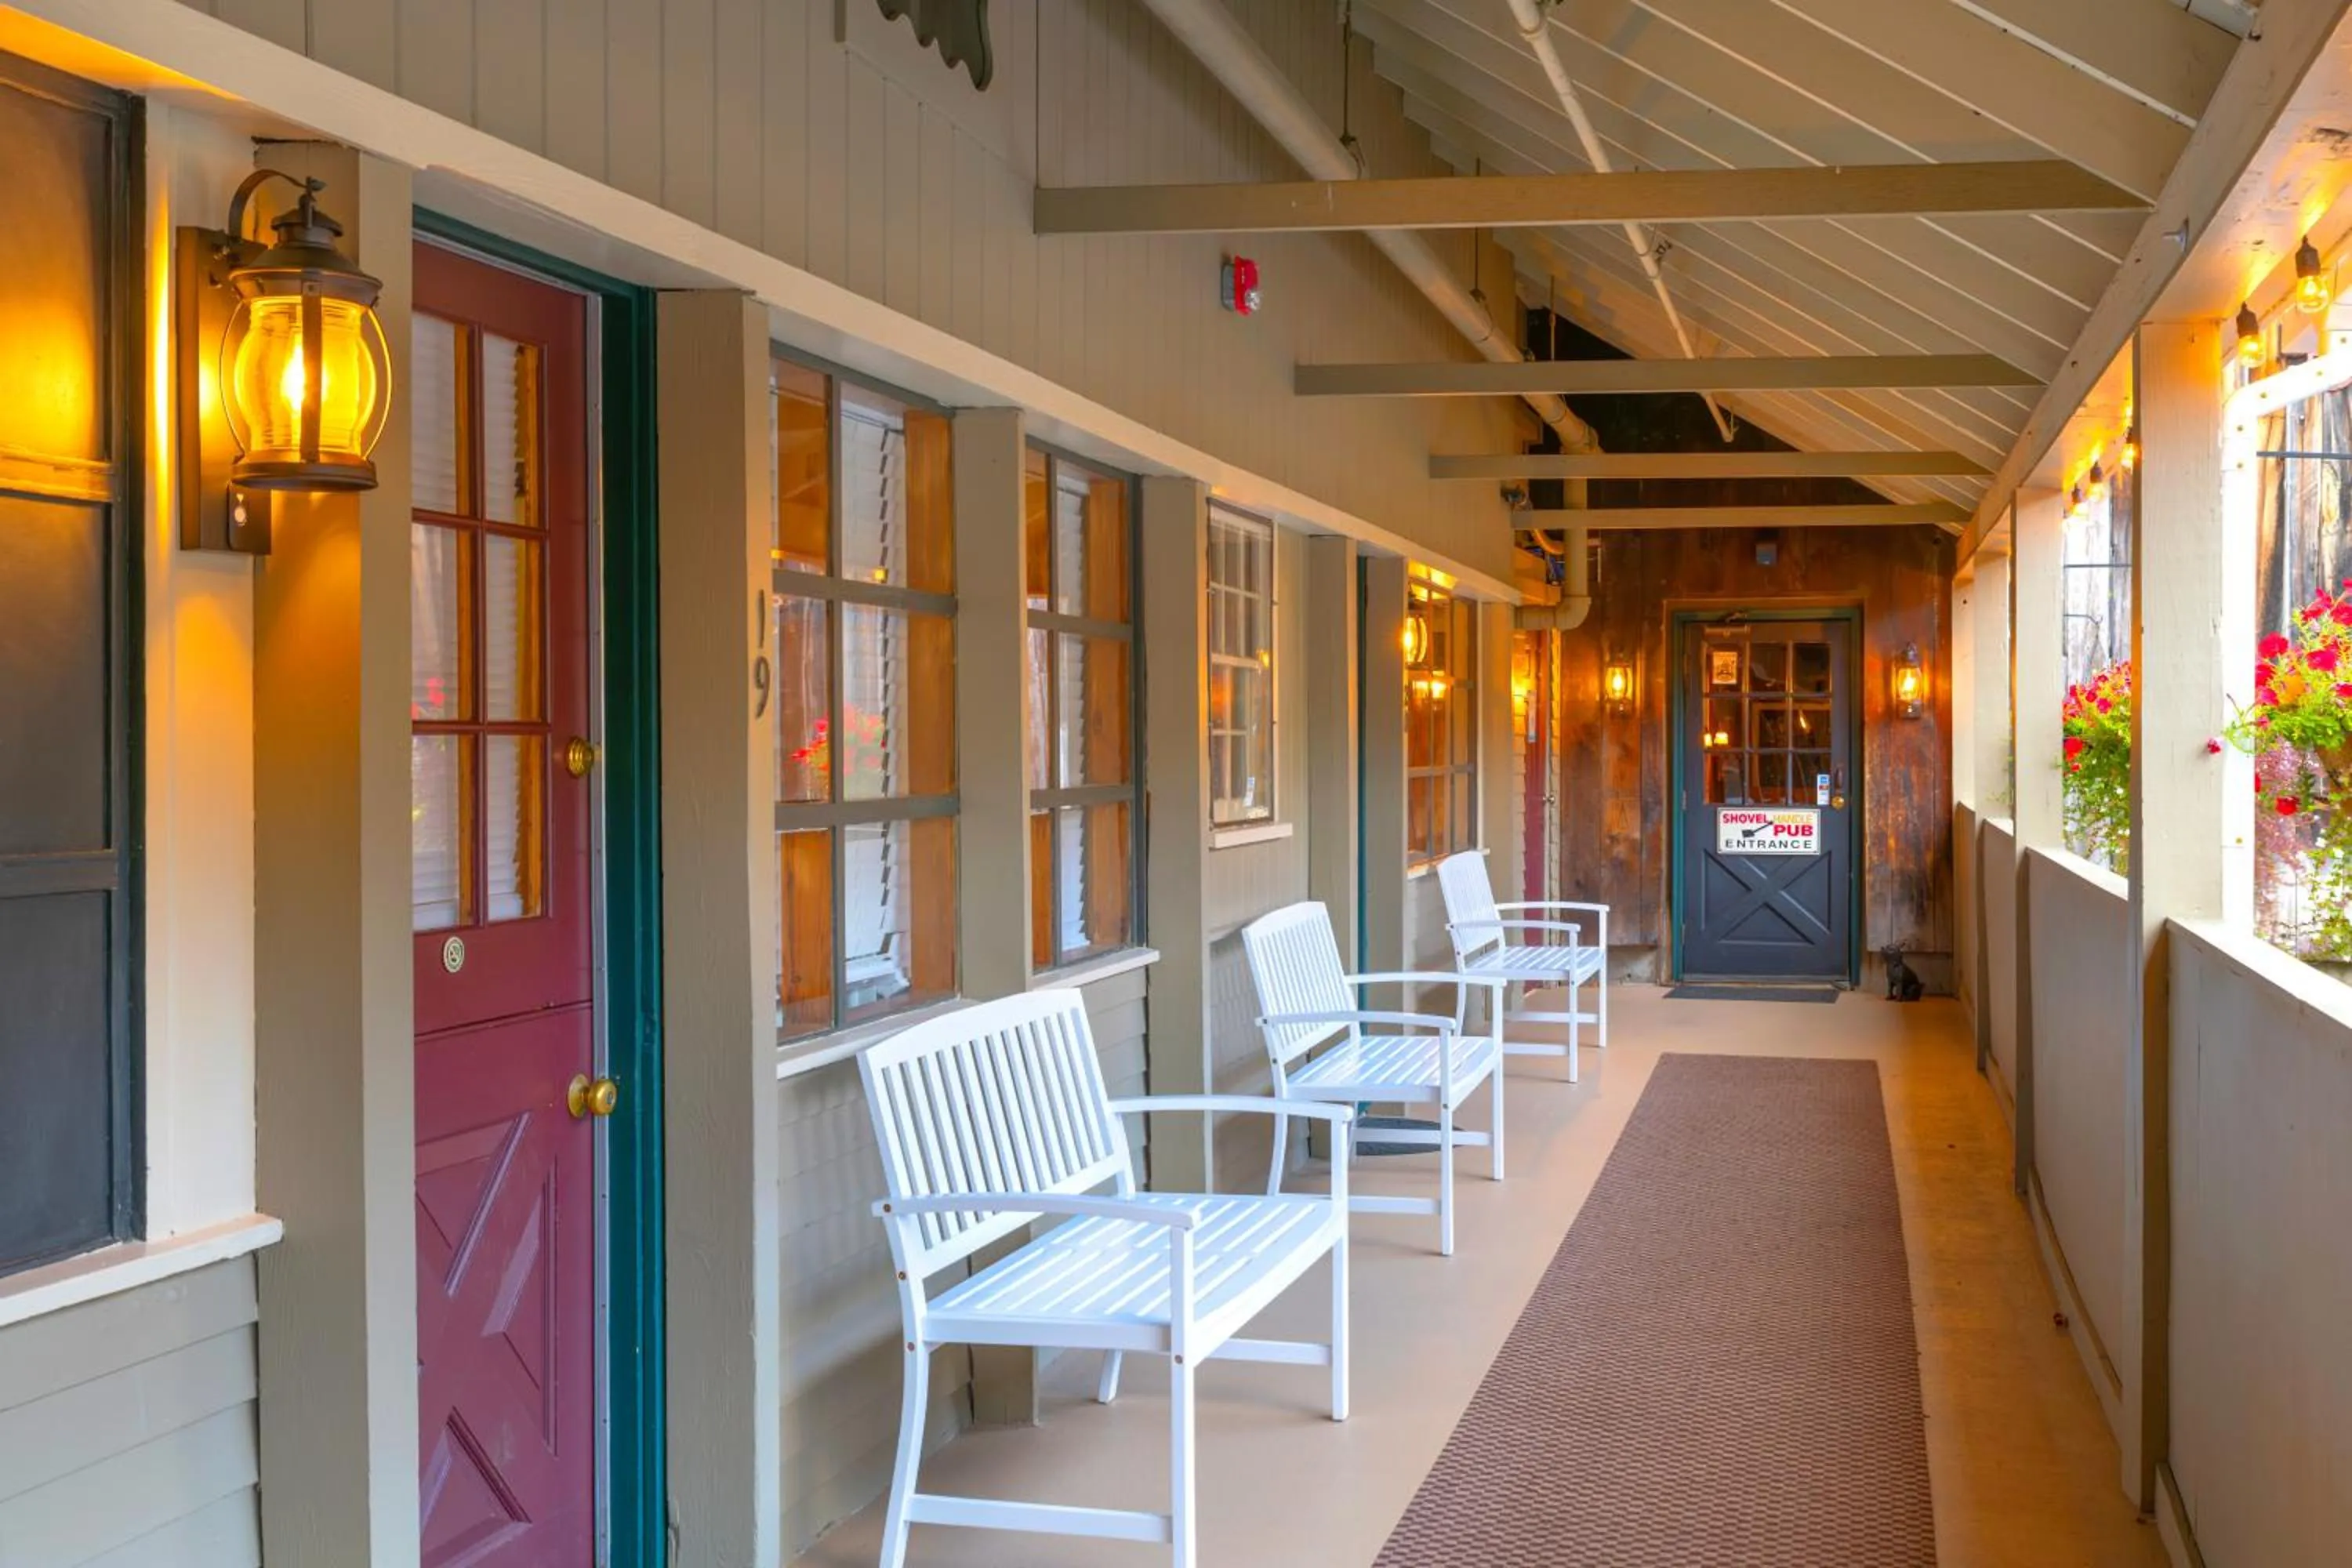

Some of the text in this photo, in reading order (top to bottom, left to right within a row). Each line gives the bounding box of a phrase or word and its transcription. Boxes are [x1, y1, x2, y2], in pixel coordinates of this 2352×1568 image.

[754, 589, 771, 719] 19
[1722, 813, 1768, 823] SHOVEL
[1773, 824, 1813, 837] PUB
[1726, 840, 1812, 849] ENTRANCE
